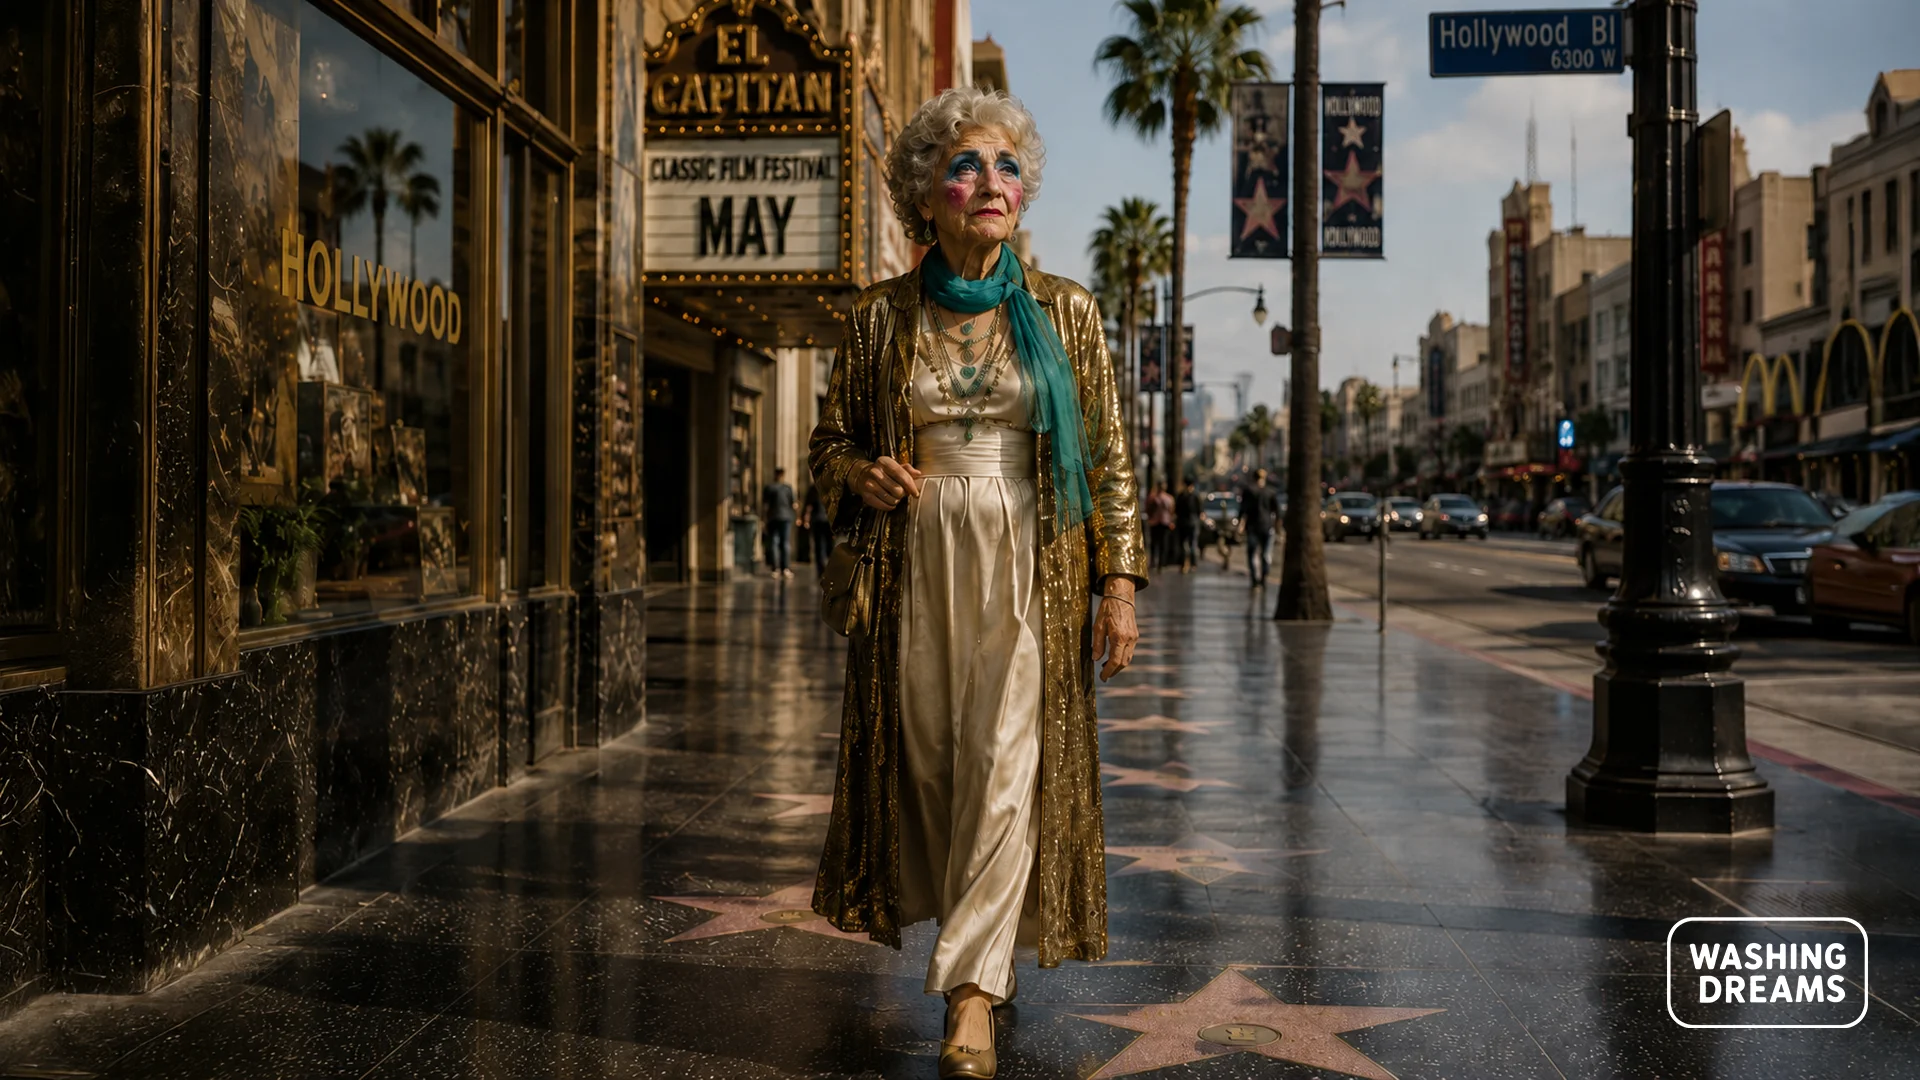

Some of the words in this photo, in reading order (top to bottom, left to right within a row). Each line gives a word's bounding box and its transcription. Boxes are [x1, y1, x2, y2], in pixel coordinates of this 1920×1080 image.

[716, 25, 769, 65] EL
[1440, 15, 1568, 55] Hollywood
[1592, 14, 1615, 45] Bl
[1551, 49, 1594, 69] 6300
[1601, 49, 1616, 67] W
[652, 72, 833, 114] CAPITAN
[1324, 96, 1381, 116] HOLLYWOOD
[651, 156, 715, 181] CLASSIC
[721, 156, 756, 181] FILM
[763, 156, 834, 181] FESTIVAL
[699, 196, 795, 256] MAY
[1324, 226, 1381, 248] HOLLYWOOD
[281, 227, 462, 344] HOLLYWOOD
